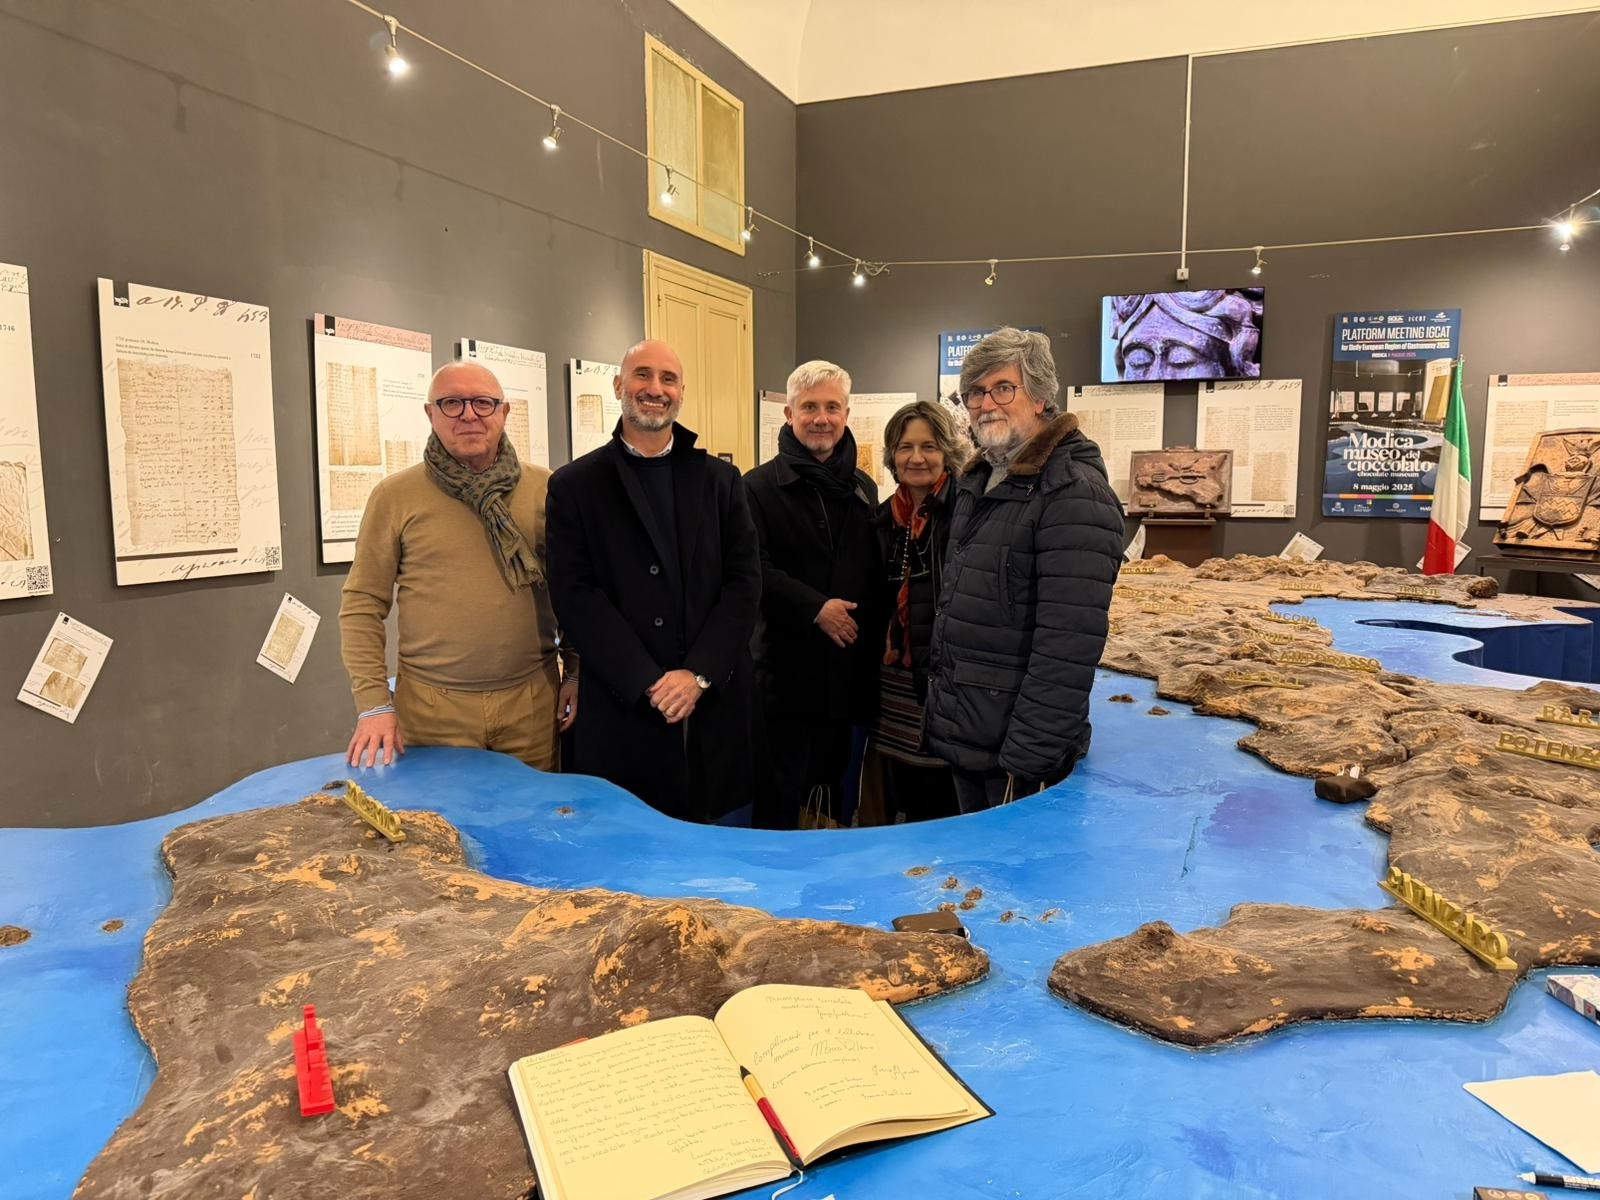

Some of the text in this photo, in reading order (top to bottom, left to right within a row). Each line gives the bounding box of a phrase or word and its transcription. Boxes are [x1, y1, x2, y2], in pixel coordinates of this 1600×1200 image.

[1341, 325, 1452, 341] PLATFORM MEETING IGCAT
[947, 345, 974, 357] PLATFO
[1349, 432, 1414, 449] Modica
[1343, 448, 1420, 461] museo del
[1347, 456, 1433, 473] cioccolato
[1357, 470, 1388, 478] chocolate
[1360, 483, 1390, 492] maggio
[1391, 483, 1414, 491] 2025
[1280, 582, 1323, 591] VENEZIA
[1398, 584, 1441, 597] TRIESTE
[1265, 609, 1318, 626] ANCONA
[1270, 648, 1381, 671] CAMPOBASSO
[1385, 865, 1510, 960] CATANZARO
